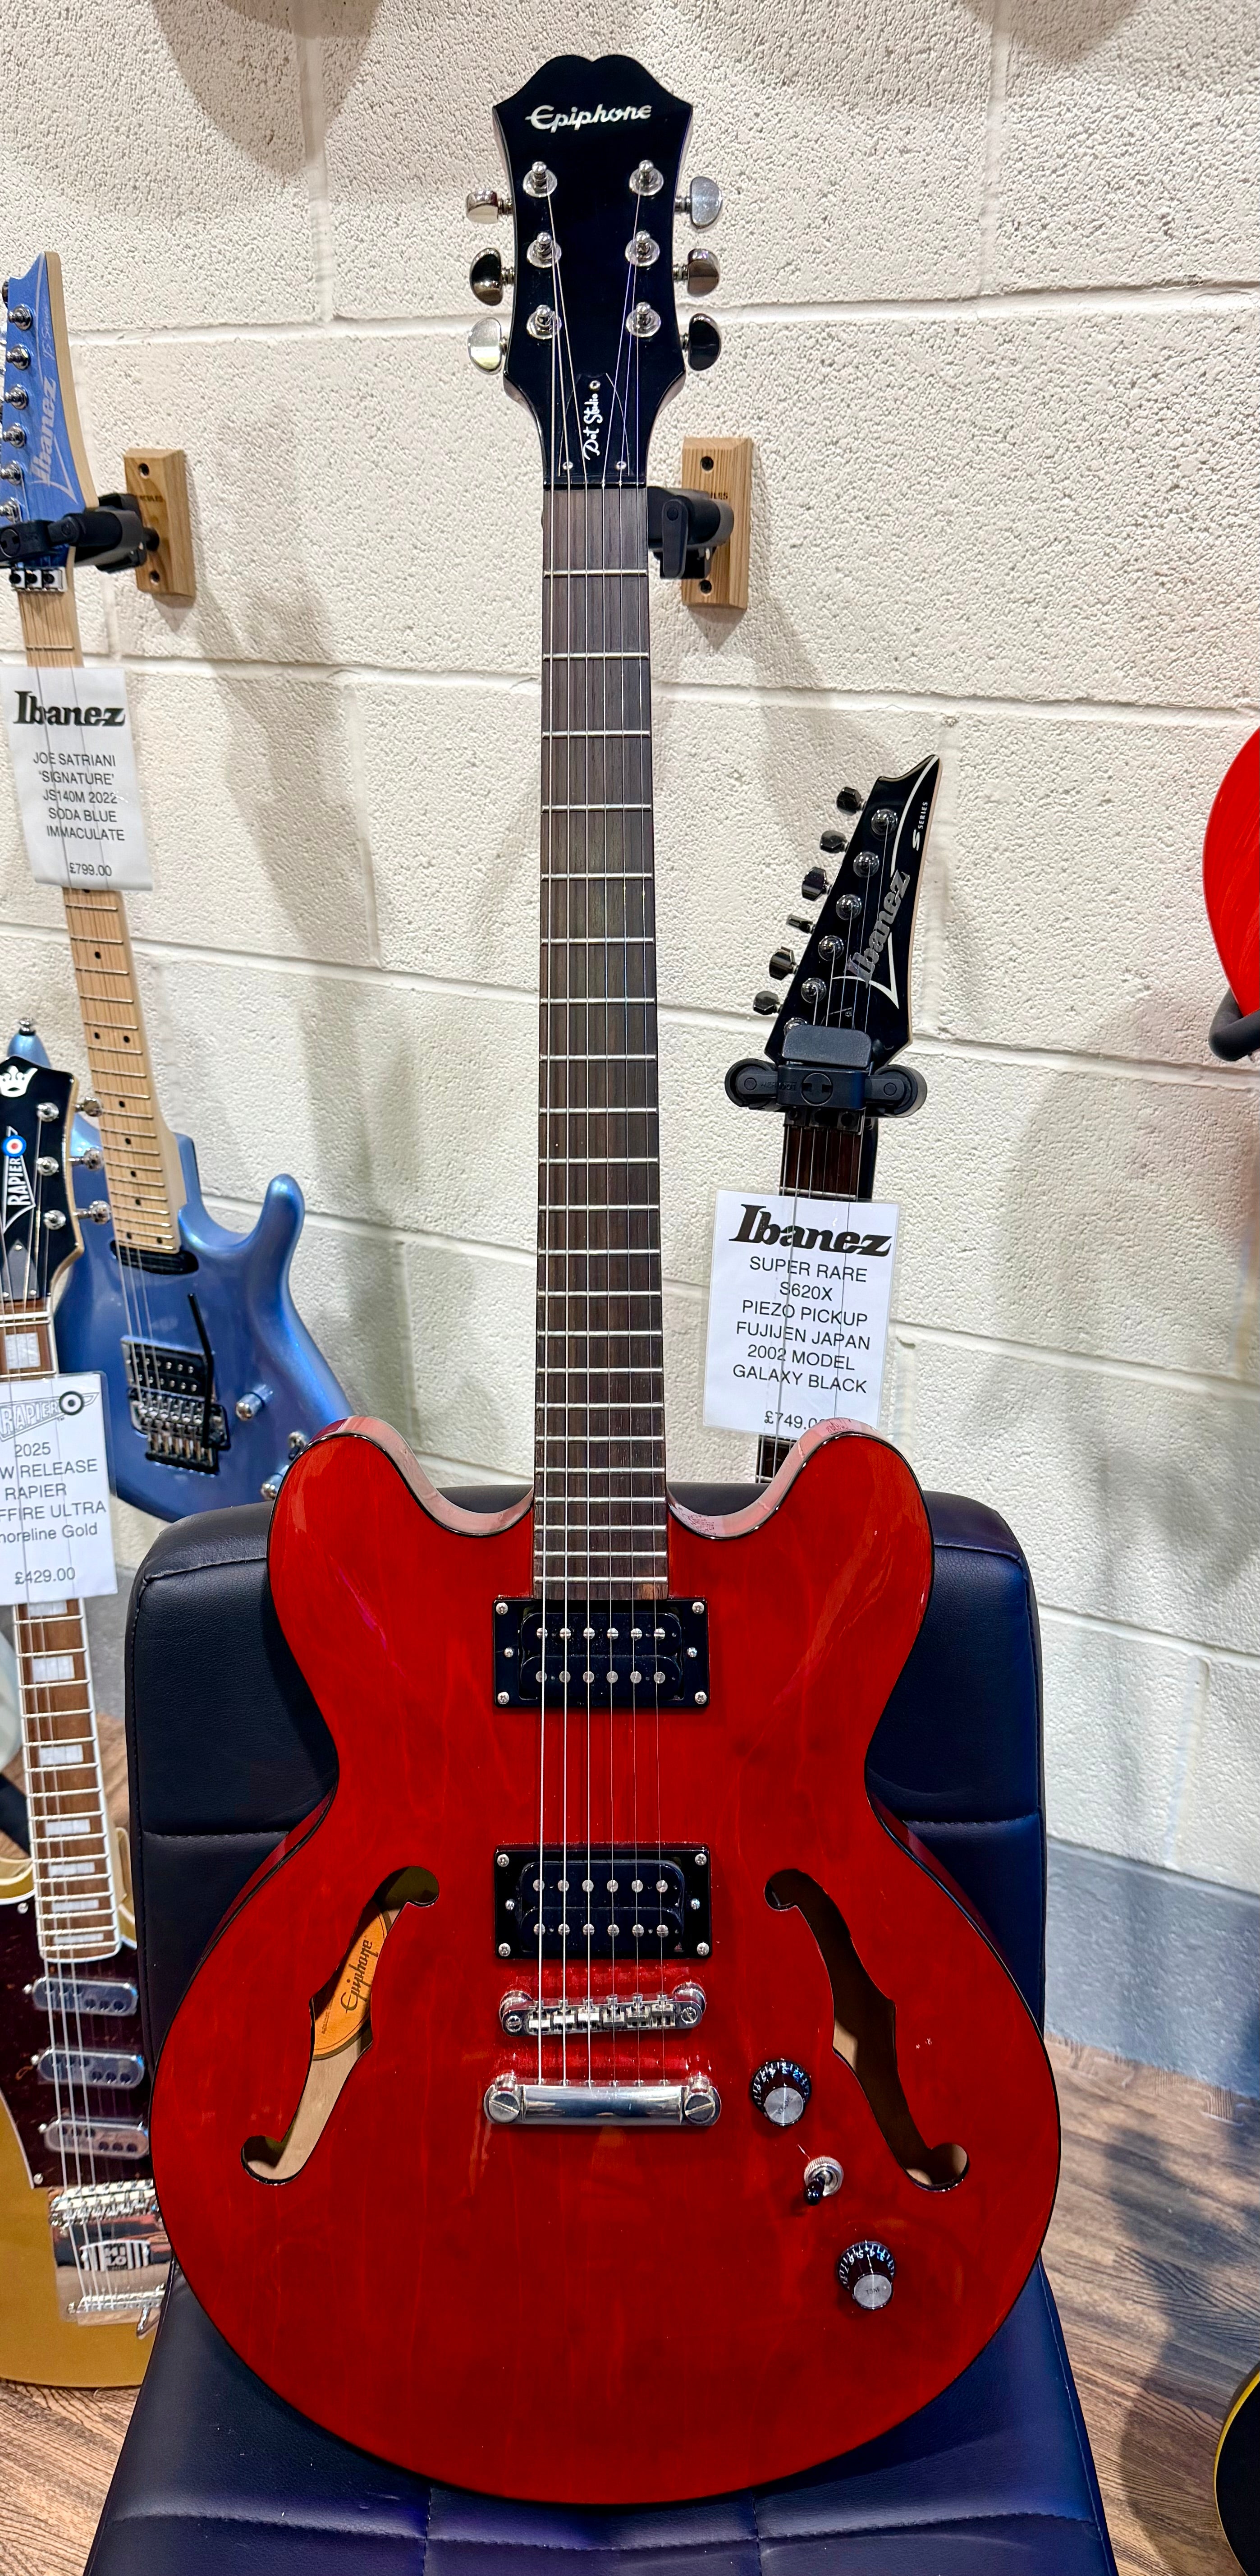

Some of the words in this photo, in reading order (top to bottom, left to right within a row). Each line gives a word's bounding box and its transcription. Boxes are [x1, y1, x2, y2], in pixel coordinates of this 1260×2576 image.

[525, 104, 652, 133] Epiphone
[583, 393, 603, 424] Studio
[30, 375, 56, 487] Ibanez
[583, 426, 600, 460] Dot
[13, 690, 126, 727] Ibanez
[33, 752, 56, 764] JOE
[59, 753, 116, 767] SATRIANI
[43, 789, 86, 803] JS140M
[88, 791, 118, 804] 2022
[48, 807, 81, 821] SODA
[84, 810, 117, 823] BLUE
[912, 828, 920, 851] S
[917, 801, 928, 829] SERIES
[46, 825, 125, 841] IMMACULATE
[69, 862, 112, 877] £799.00
[843, 869, 910, 989] Ibanez
[7, 1157, 32, 1205] RAPIER
[729, 1204, 893, 1257] Ibanez
[750, 1256, 811, 1277] SUPER
[817, 1264, 868, 1282] RARE
[779, 1282, 833, 1301] S620X
[742, 1300, 795, 1319] PIEZO
[800, 1307, 868, 1327] PICKUP
[736, 1321, 806, 1343] FUJIJEN
[811, 1331, 870, 1350] JAPAN
[747, 1344, 787, 1361] 2002
[792, 1349, 855, 1371] MODEL
[733, 1364, 803, 1385] GALAXY
[808, 1374, 867, 1393] BLACK
[0, 1400, 59, 1435] RAPIER
[764, 1410, 825, 1430] £749.0
[15, 1441, 51, 1458] 2025
[0, 1466, 14, 1480] W
[20, 1458, 98, 1478] RELEASE
[5, 1482, 67, 1500] RAPIER
[0, 1505, 45, 1522] FFIRE
[50, 1500, 106, 1518] ULTRA
[62, 1522, 97, 1538] Gold
[15, 1567, 76, 1585] £429.00
[340, 1940, 379, 2014] Epiphone
